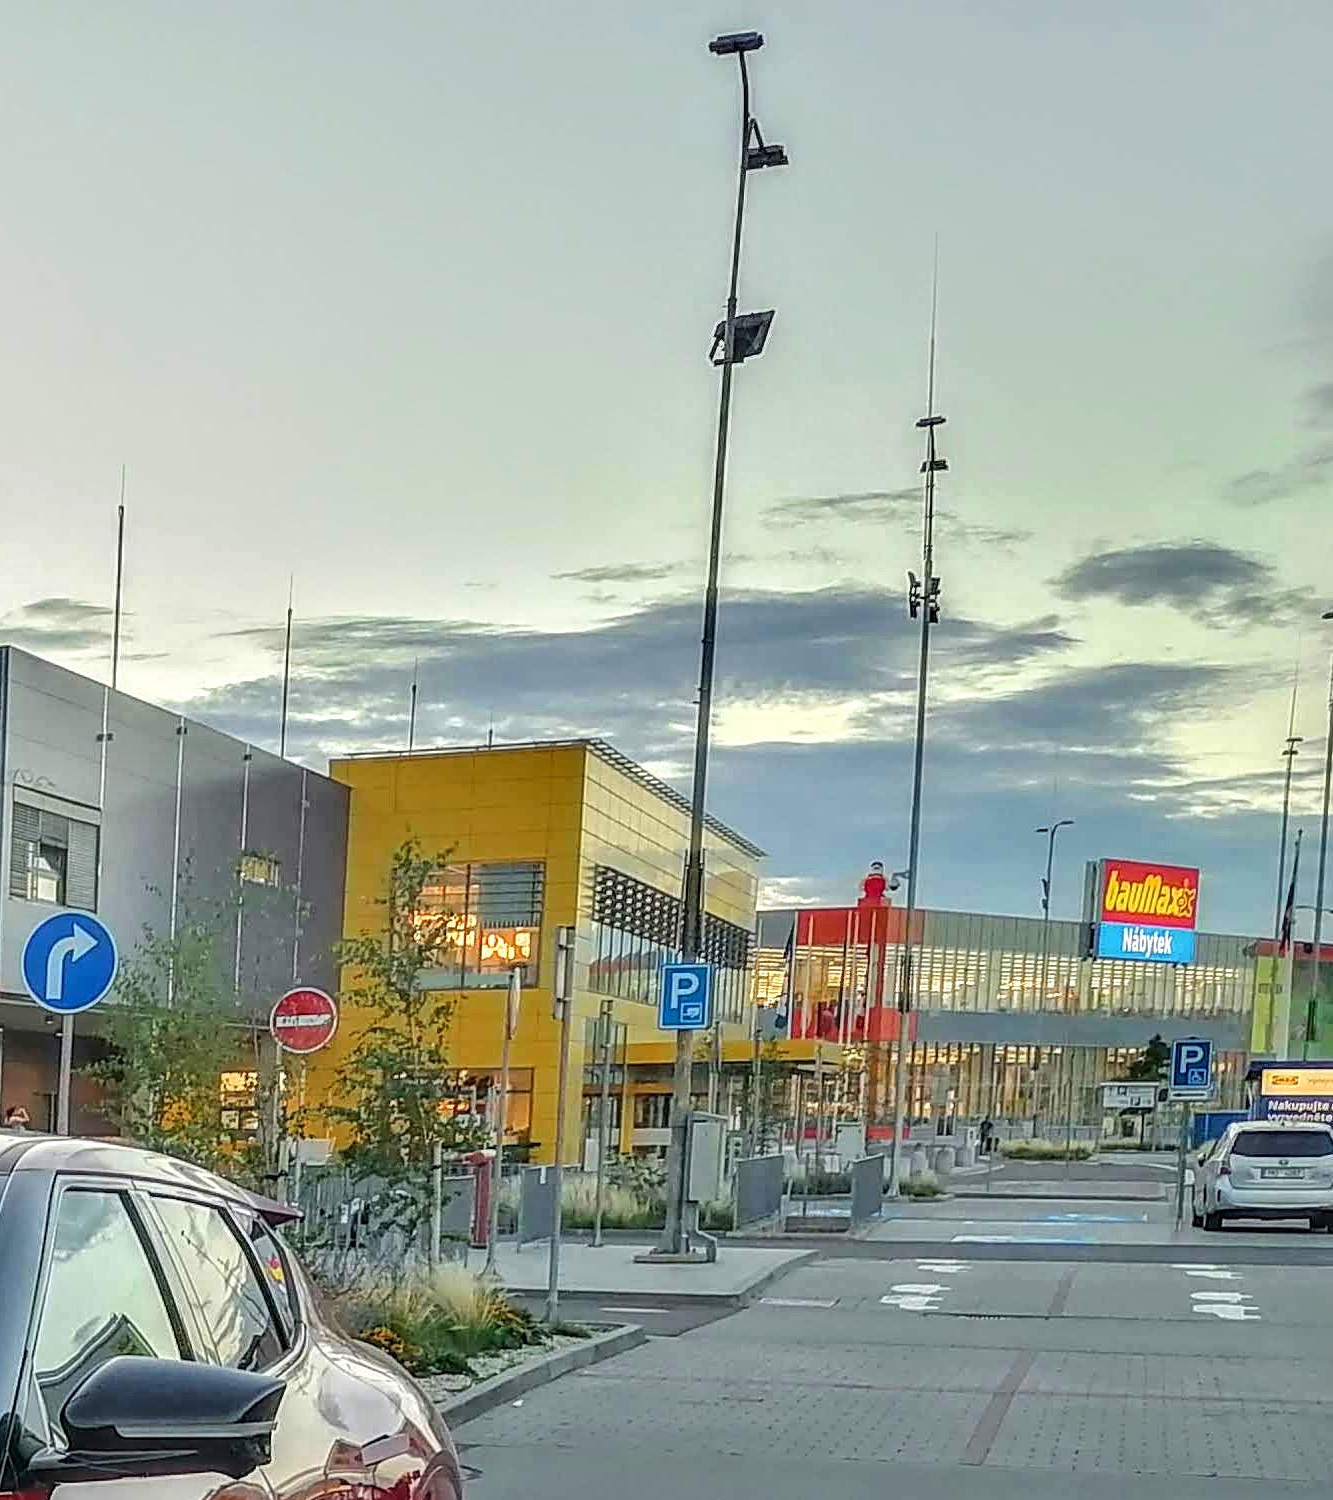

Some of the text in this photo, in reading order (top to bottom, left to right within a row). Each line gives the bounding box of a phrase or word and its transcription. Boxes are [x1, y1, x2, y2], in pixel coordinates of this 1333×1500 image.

[1121, 926, 1173, 959] Nábytek
[670, 972, 700, 1010] P
[1179, 1045, 1204, 1074] P
